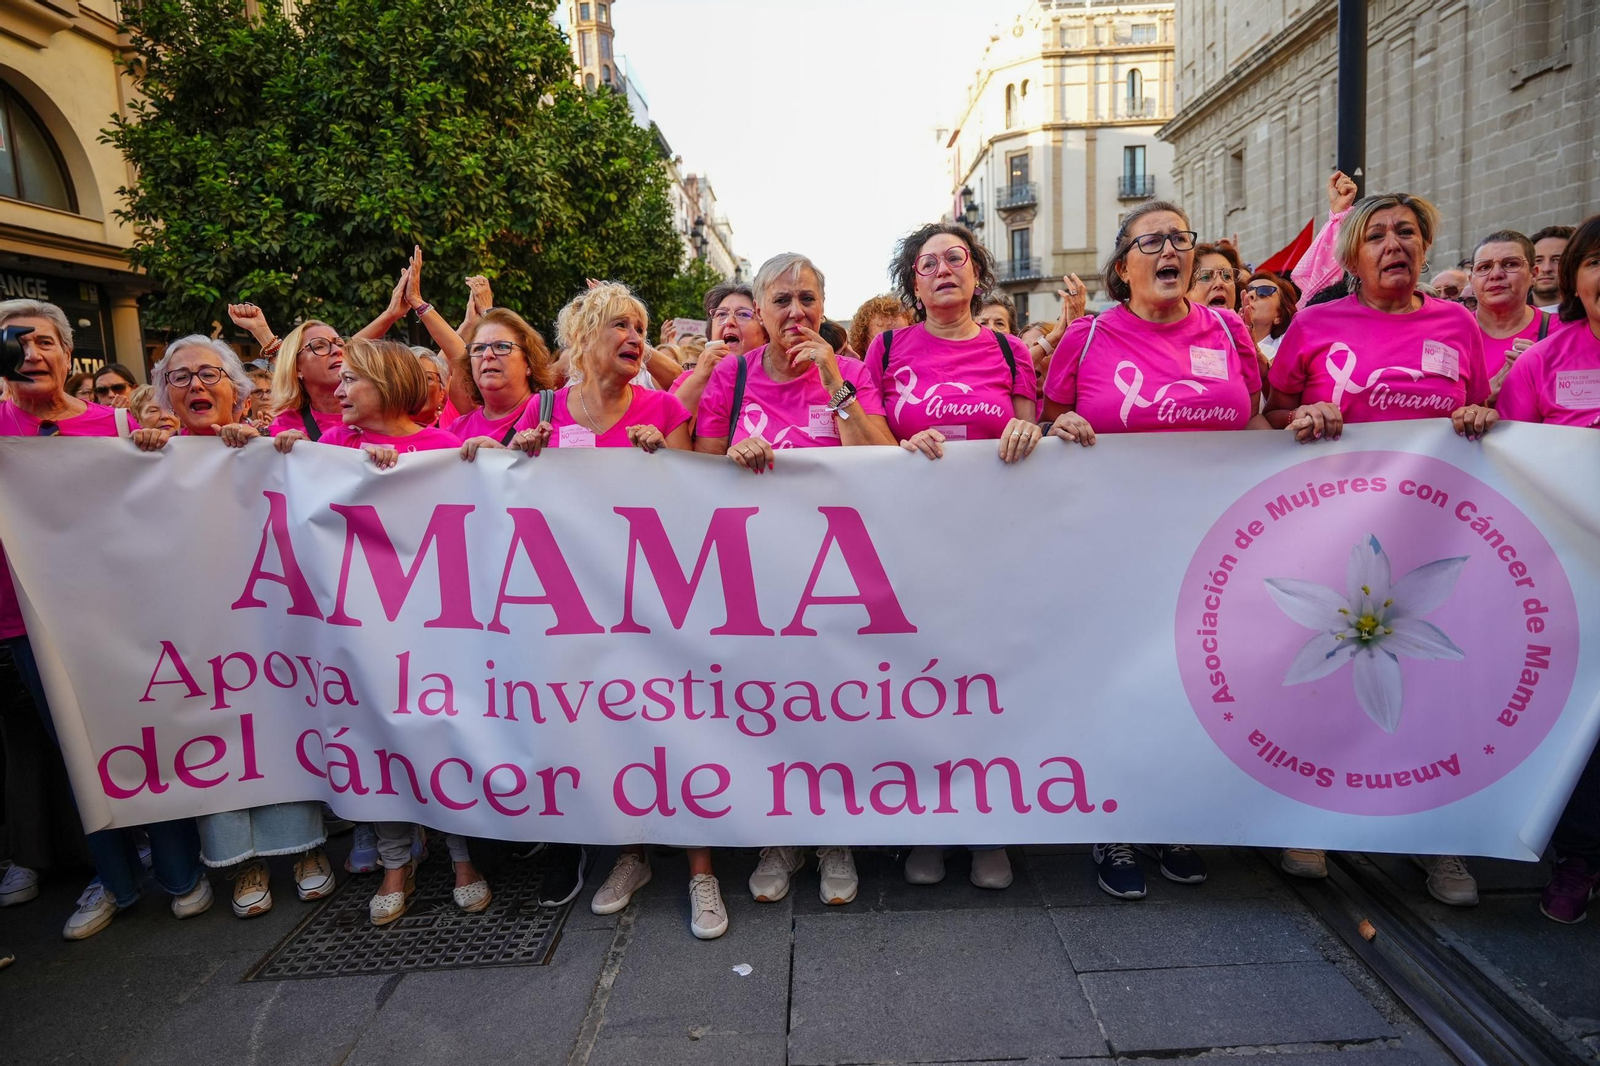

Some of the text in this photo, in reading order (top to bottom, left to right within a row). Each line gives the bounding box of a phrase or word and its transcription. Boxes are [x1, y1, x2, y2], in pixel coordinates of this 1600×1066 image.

[1425, 347, 1435, 355] NO
[72, 357, 105, 375] ATM
[1558, 380, 1571, 389] NO
[810, 412, 821, 420] NO
[925, 395, 1005, 418] Amama
[1157, 398, 1240, 424] Amama
[231, 490, 918, 637] AMAMA
[1197, 476, 1552, 728] Asociación de Mujeres con Cáncer de Mama
[139, 640, 1005, 738] Apoya la investigación
[97, 713, 1119, 819] del cáncer de mama.
[1247, 729, 1462, 790] Amama Sevilla
